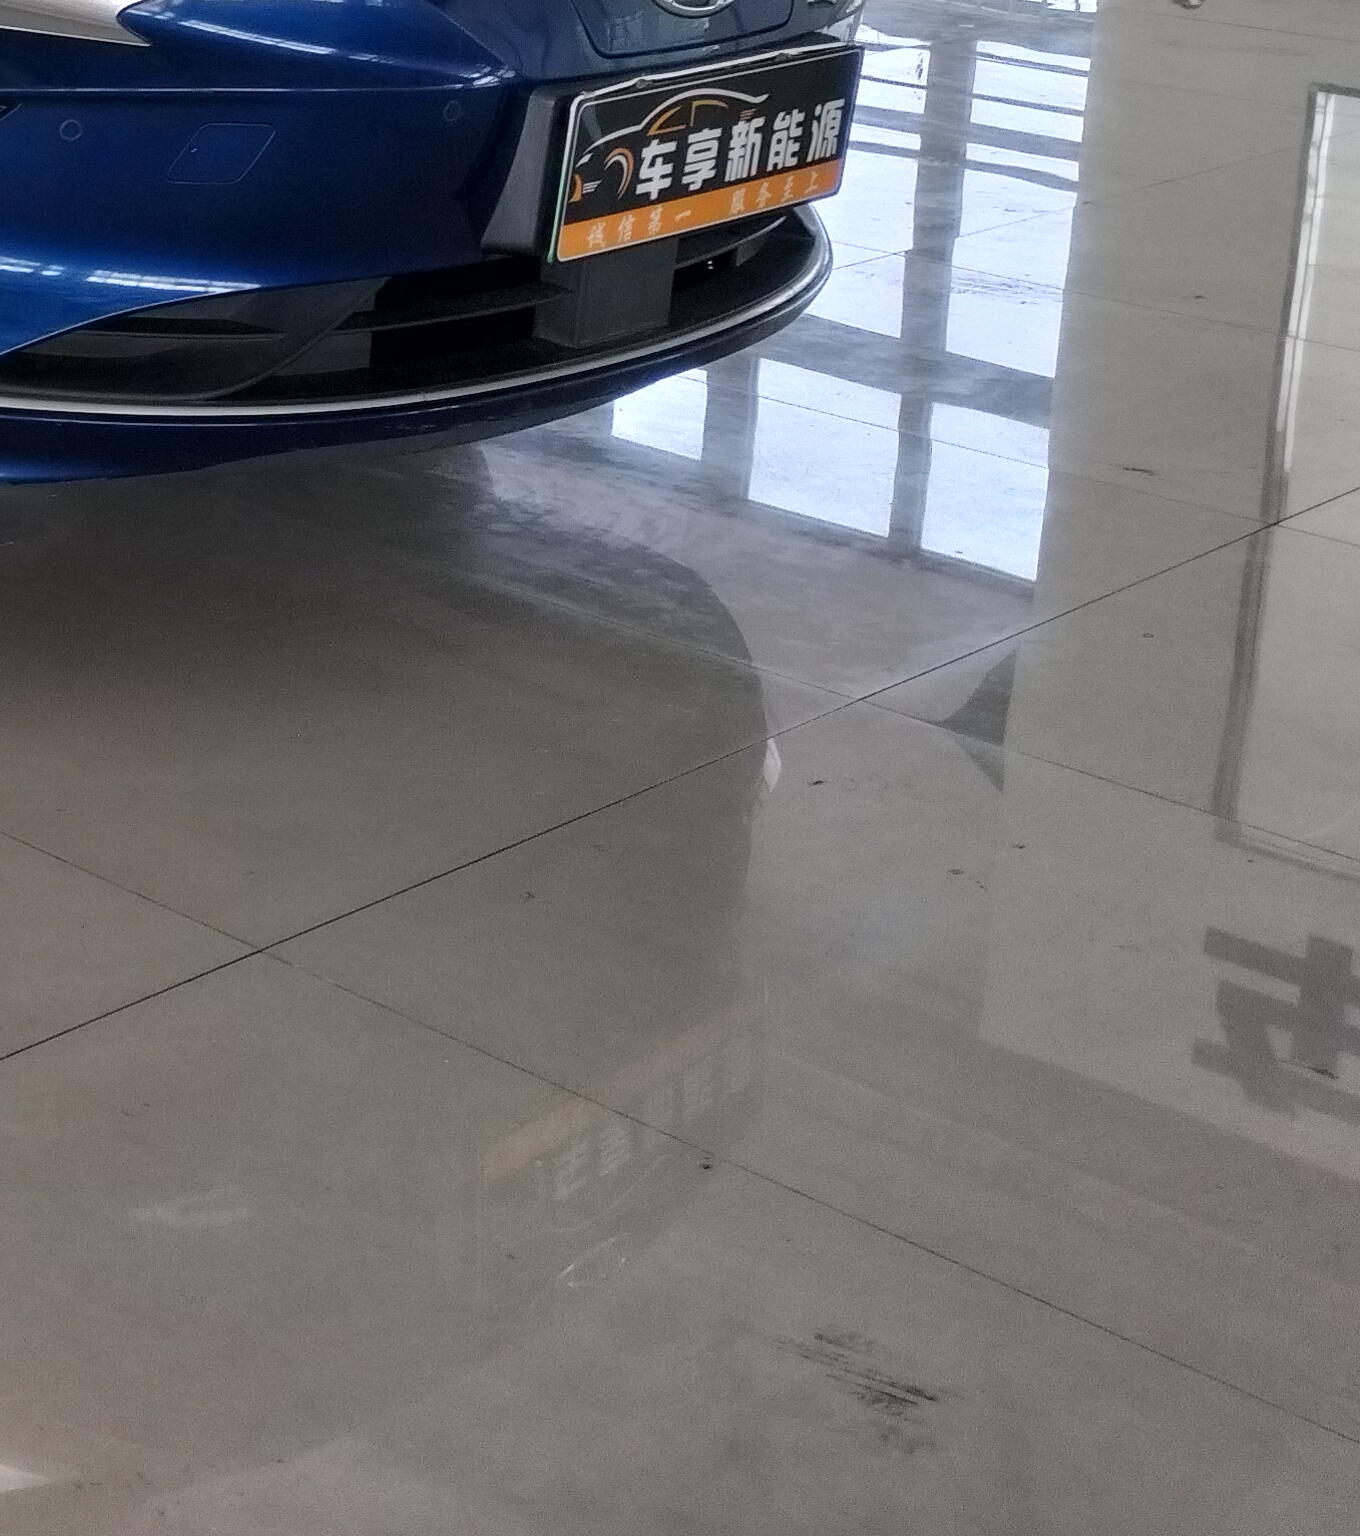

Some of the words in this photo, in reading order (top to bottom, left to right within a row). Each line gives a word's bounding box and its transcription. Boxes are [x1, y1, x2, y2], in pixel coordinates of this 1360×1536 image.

[635, 98, 846, 200] 车享新能源
